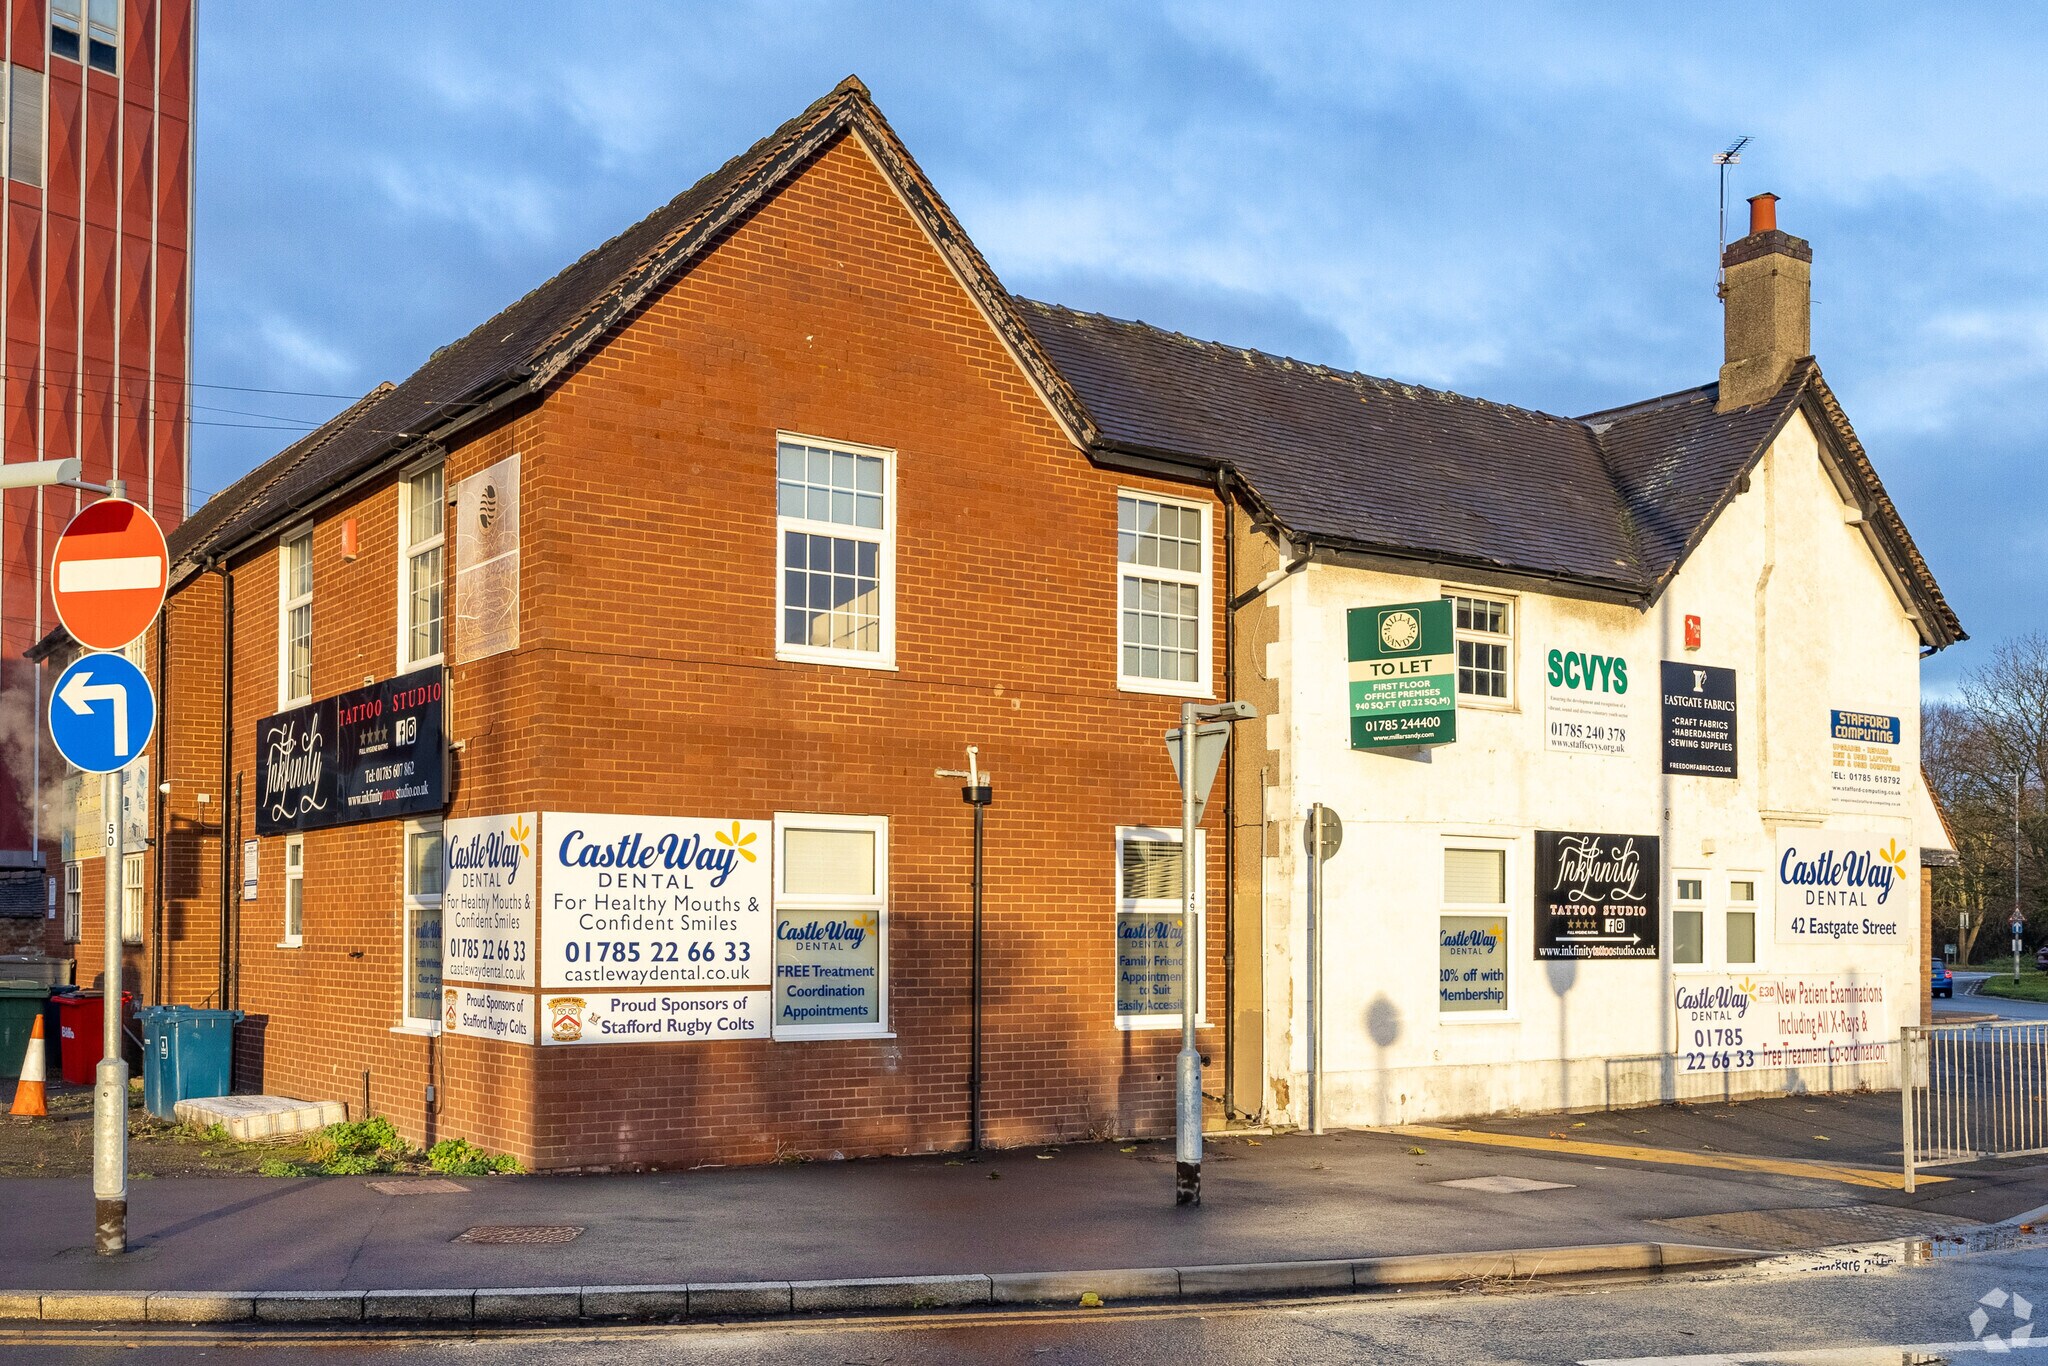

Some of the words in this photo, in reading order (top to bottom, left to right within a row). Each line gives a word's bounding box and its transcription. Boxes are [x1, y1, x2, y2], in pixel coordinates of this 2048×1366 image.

[1383, 613, 1416, 632] MILLAR
[1385, 632, 1415, 647] SANDY
[1370, 663, 1395, 676] TO
[1400, 659, 1432, 674] LET
[1547, 649, 1628, 694] SCVYS
[1364, 691, 1396, 700] OFFICE
[1398, 688, 1440, 698] PREMISES
[1373, 682, 1398, 691] FIRST
[1400, 680, 1430, 689] FLOOR
[339, 699, 382, 727] TATTOO
[393, 682, 441, 712] STUDIO
[1355, 702, 1369, 710] 940
[1371, 700, 1396, 709] SQ.FT
[1664, 694, 1702, 710] EASTGATE
[1704, 698, 1735, 712] FABRICS
[1365, 719, 1398, 732] 01785
[1401, 716, 1440, 730] 244400
[1674, 717, 1697, 726] CRAFT
[1699, 718, 1728, 730] FABRICS
[1838, 711, 1890, 729] STAFFORD
[1373, 731, 1434, 741] www.millarsandy.com
[1551, 721, 1582, 738] 01785
[1586, 725, 1604, 740] 240
[1607, 727, 1626, 742] 378
[1674, 728, 1728, 740] HABERDASHERY
[1835, 725, 1894, 743] COMPUTING
[1551, 739, 1625, 754] www.staffscvys.org.uk
[1670, 739, 1698, 749] SEWING
[1700, 741, 1733, 751] SUPPLIES
[376, 766, 392, 782] 01785
[393, 763, 403, 779] 607
[403, 760, 415, 776] 862
[1669, 762, 1731, 773] FREEDOMFABRICS.CO.UK
[1849, 773, 1871, 782] 01785
[1874, 775, 1900, 785] 618792
[462, 872, 501, 888] DENTAL
[598, 872, 694, 890] DENTAL
[447, 893, 459, 909] For
[461, 893, 490, 914] Healthy
[492, 893, 522, 910] Mouths
[524, 893, 531, 910] &
[554, 893, 586, 910] For
[595, 893, 666, 916] Healthy
[674, 895, 740, 912] Mouths
[747, 897, 760, 912] &
[1806, 890, 1866, 907] DENTAL
[1550, 905, 1596, 915] TATTOO
[1603, 905, 1646, 916] STUDIO
[455, 912, 493, 930] Confident
[495, 912, 520, 930] Smiles
[579, 913, 677, 931] Confident
[681, 914, 737, 931] Smiles
[1791, 917, 1805, 934] 42
[1810, 917, 1858, 939] Eastgate
[1862, 919, 1897, 935] Street
[450, 938, 478, 959] 01785
[483, 939, 494, 960] 22
[498, 939, 509, 961] 66
[513, 940, 526, 963] 33
[565, 941, 640, 962] 01785
[650, 942, 679, 962] 22
[687, 941, 715, 962] 66
[724, 941, 751, 962] 33
[796, 942, 843, 950] DENTAL
[1131, 940, 1169, 948] DENTAL
[1450, 947, 1482, 955] DENTAL
[1539, 945, 1656, 959] www.inkfinitytattoostudio.co.uk
[1119, 955, 1151, 967] Family
[450, 962, 526, 981] castlewaydental.co.uk
[565, 964, 750, 985] castlewaydental.co.uk
[777, 965, 810, 977] FREE
[812, 964, 874, 977] Treatment
[1121, 971, 1183, 985] Appointmen
[1440, 968, 1458, 982] 20%
[1463, 968, 1478, 981] off
[1481, 968, 1504, 981] with
[787, 985, 865, 997] Coordination
[1139, 986, 1149, 995] to
[1153, 984, 1171, 995] Suit
[1440, 987, 1504, 1003] Membership
[1758, 986, 1774, 998] £30
[1776, 981, 1796, 1004] New
[1799, 981, 1828, 1004] Patient
[1830, 981, 1882, 1004] Examinations
[466, 993, 485, 1009] Proud
[487, 994, 515, 1013] Sponsors
[517, 997, 524, 1012] of
[610, 997, 657, 1012] Proud
[661, 997, 730, 1014] Sponsors
[733, 996, 748, 1010] of
[783, 1004, 868, 1019] Appointments
[1118, 999, 1143, 1013] Easily
[1692, 1010, 1731, 1021] DENTAL
[463, 1014, 487, 1029] Stafford
[489, 1016, 508, 1036] Rugby
[509, 1019, 527, 1035] Colts
[601, 1018, 662, 1034] Stafford
[667, 1018, 712, 1035] Rugby
[716, 1017, 755, 1031] Colts
[1778, 1011, 1817, 1040] Including
[1817, 1010, 1829, 1034] All
[1831, 1010, 1859, 1039] X-Rays
[1861, 1011, 1868, 1032] &
[1695, 1028, 1743, 1047] 01785
[1686, 1052, 1706, 1070] 22
[1712, 1051, 1730, 1068] 66
[1736, 1050, 1754, 1067] 33
[1763, 1043, 1782, 1066] Free
[1783, 1041, 1826, 1065] Treatment
[1828, 1040, 1885, 1063] Co-ordination
